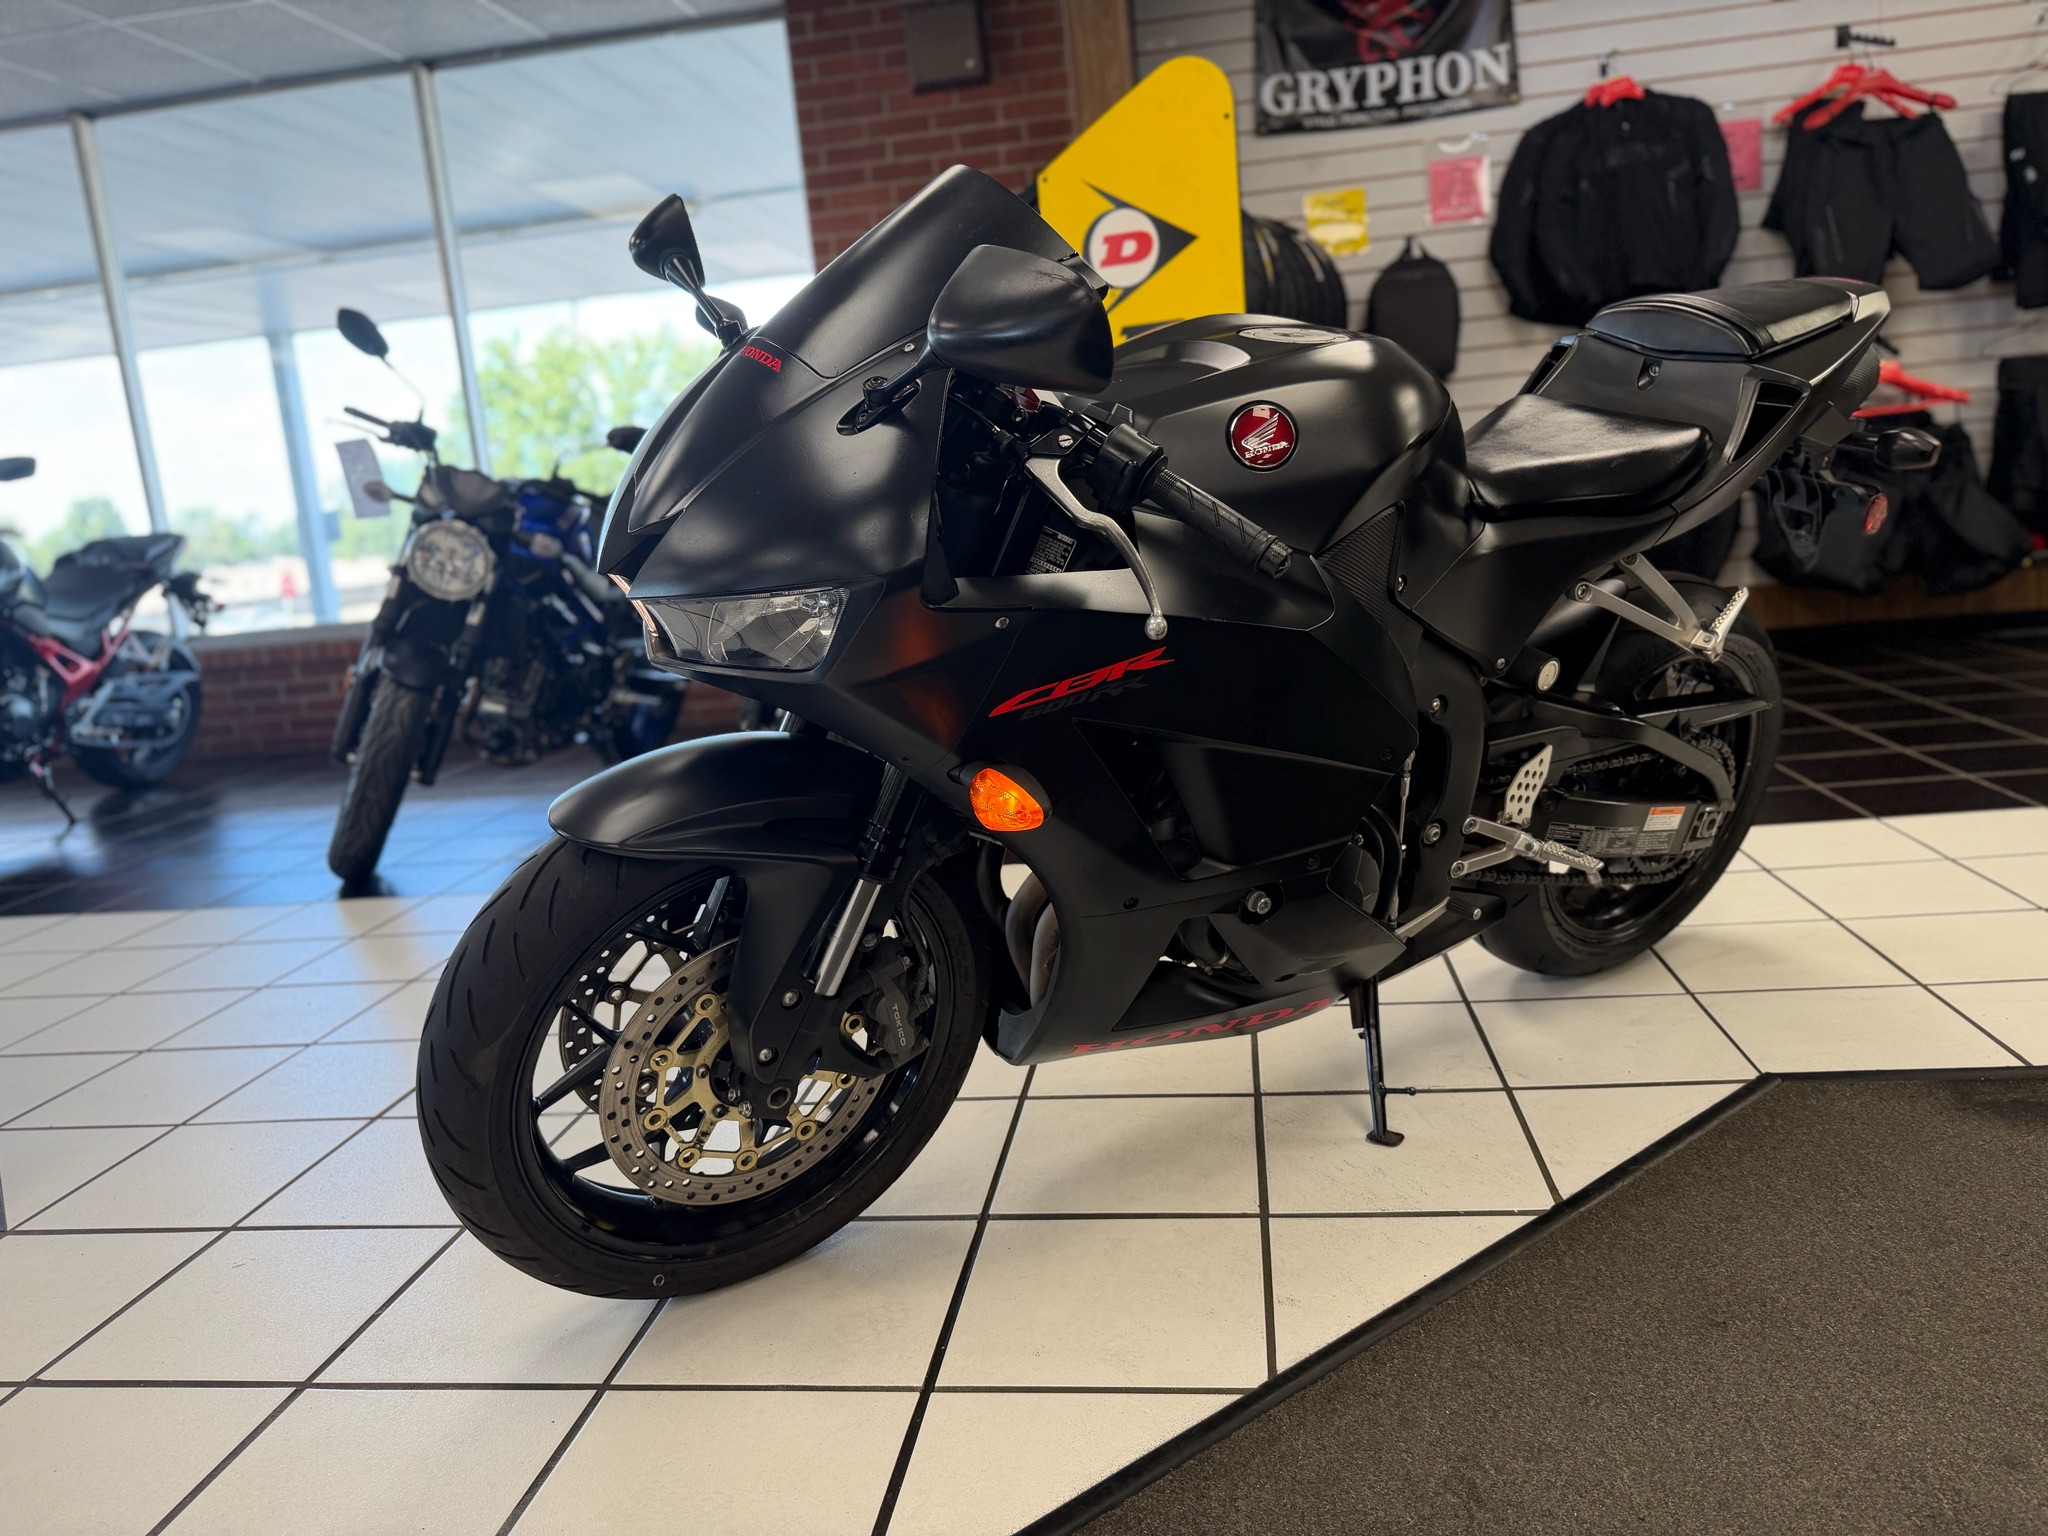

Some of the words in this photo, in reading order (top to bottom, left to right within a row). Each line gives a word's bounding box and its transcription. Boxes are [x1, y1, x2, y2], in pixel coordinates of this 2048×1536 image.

[1260, 43, 1512, 117] GRYPHON
[1099, 230, 1153, 269] D
[1244, 440, 1290, 459] HONDA
[988, 646, 1175, 717] CBR
[892, 1003, 906, 1047] TOKICO
[1070, 997, 1331, 1056] HONDA
